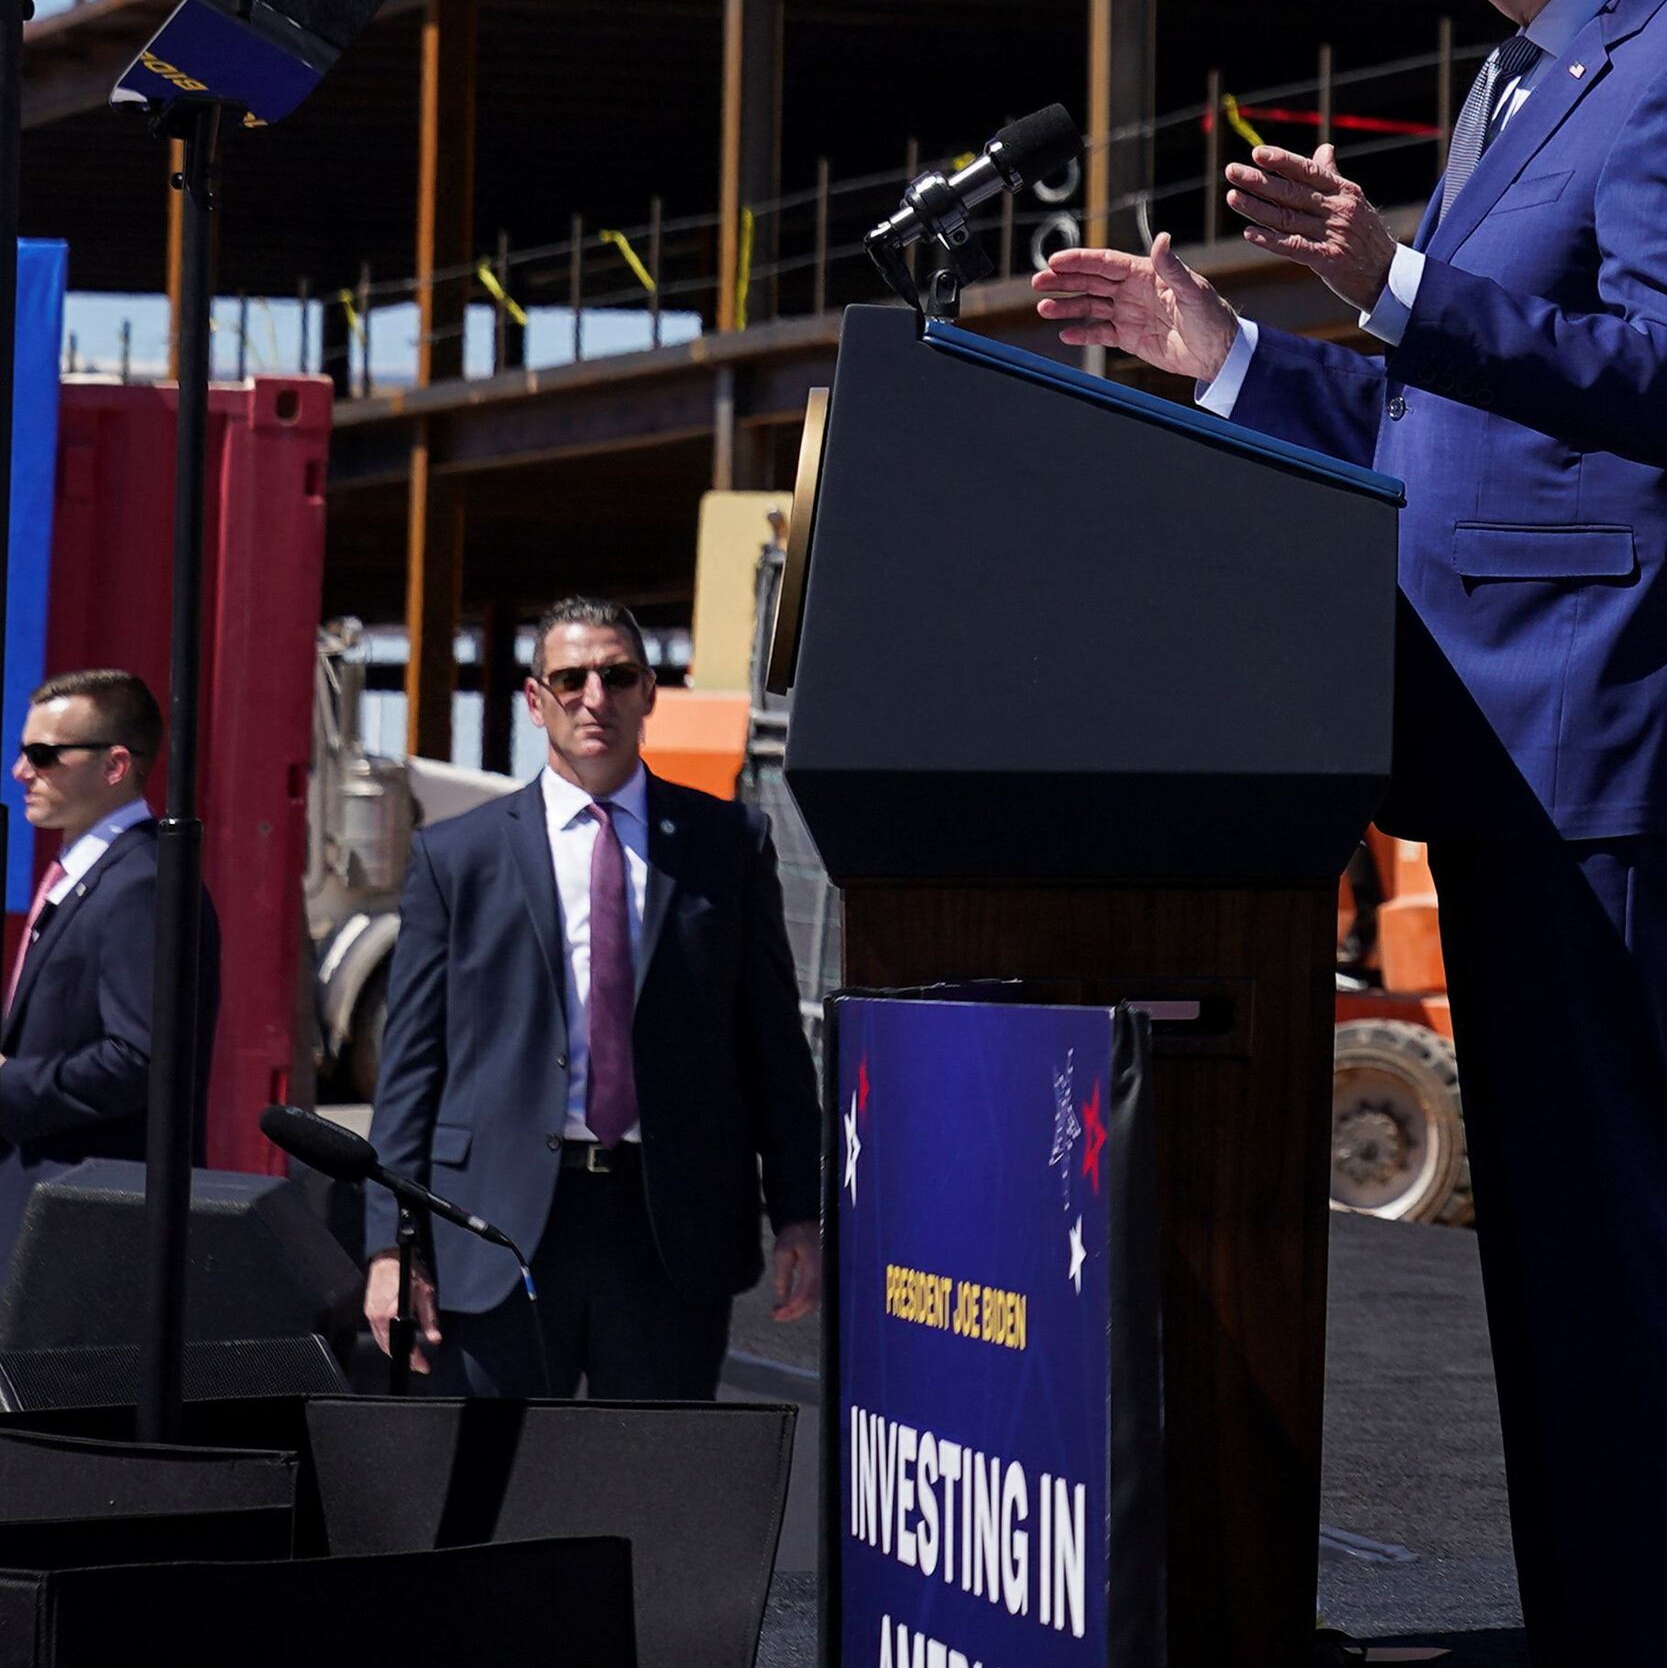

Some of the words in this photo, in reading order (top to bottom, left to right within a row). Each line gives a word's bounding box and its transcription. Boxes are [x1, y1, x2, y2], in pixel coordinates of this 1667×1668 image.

[886, 1264, 952, 1331] PRESIDENT
[953, 1280, 981, 1339] JOE
[982, 1285, 1027, 1351] BIDEN
[851, 1405, 1029, 1617] INVESTING
[1039, 1472, 1087, 1640] IN
